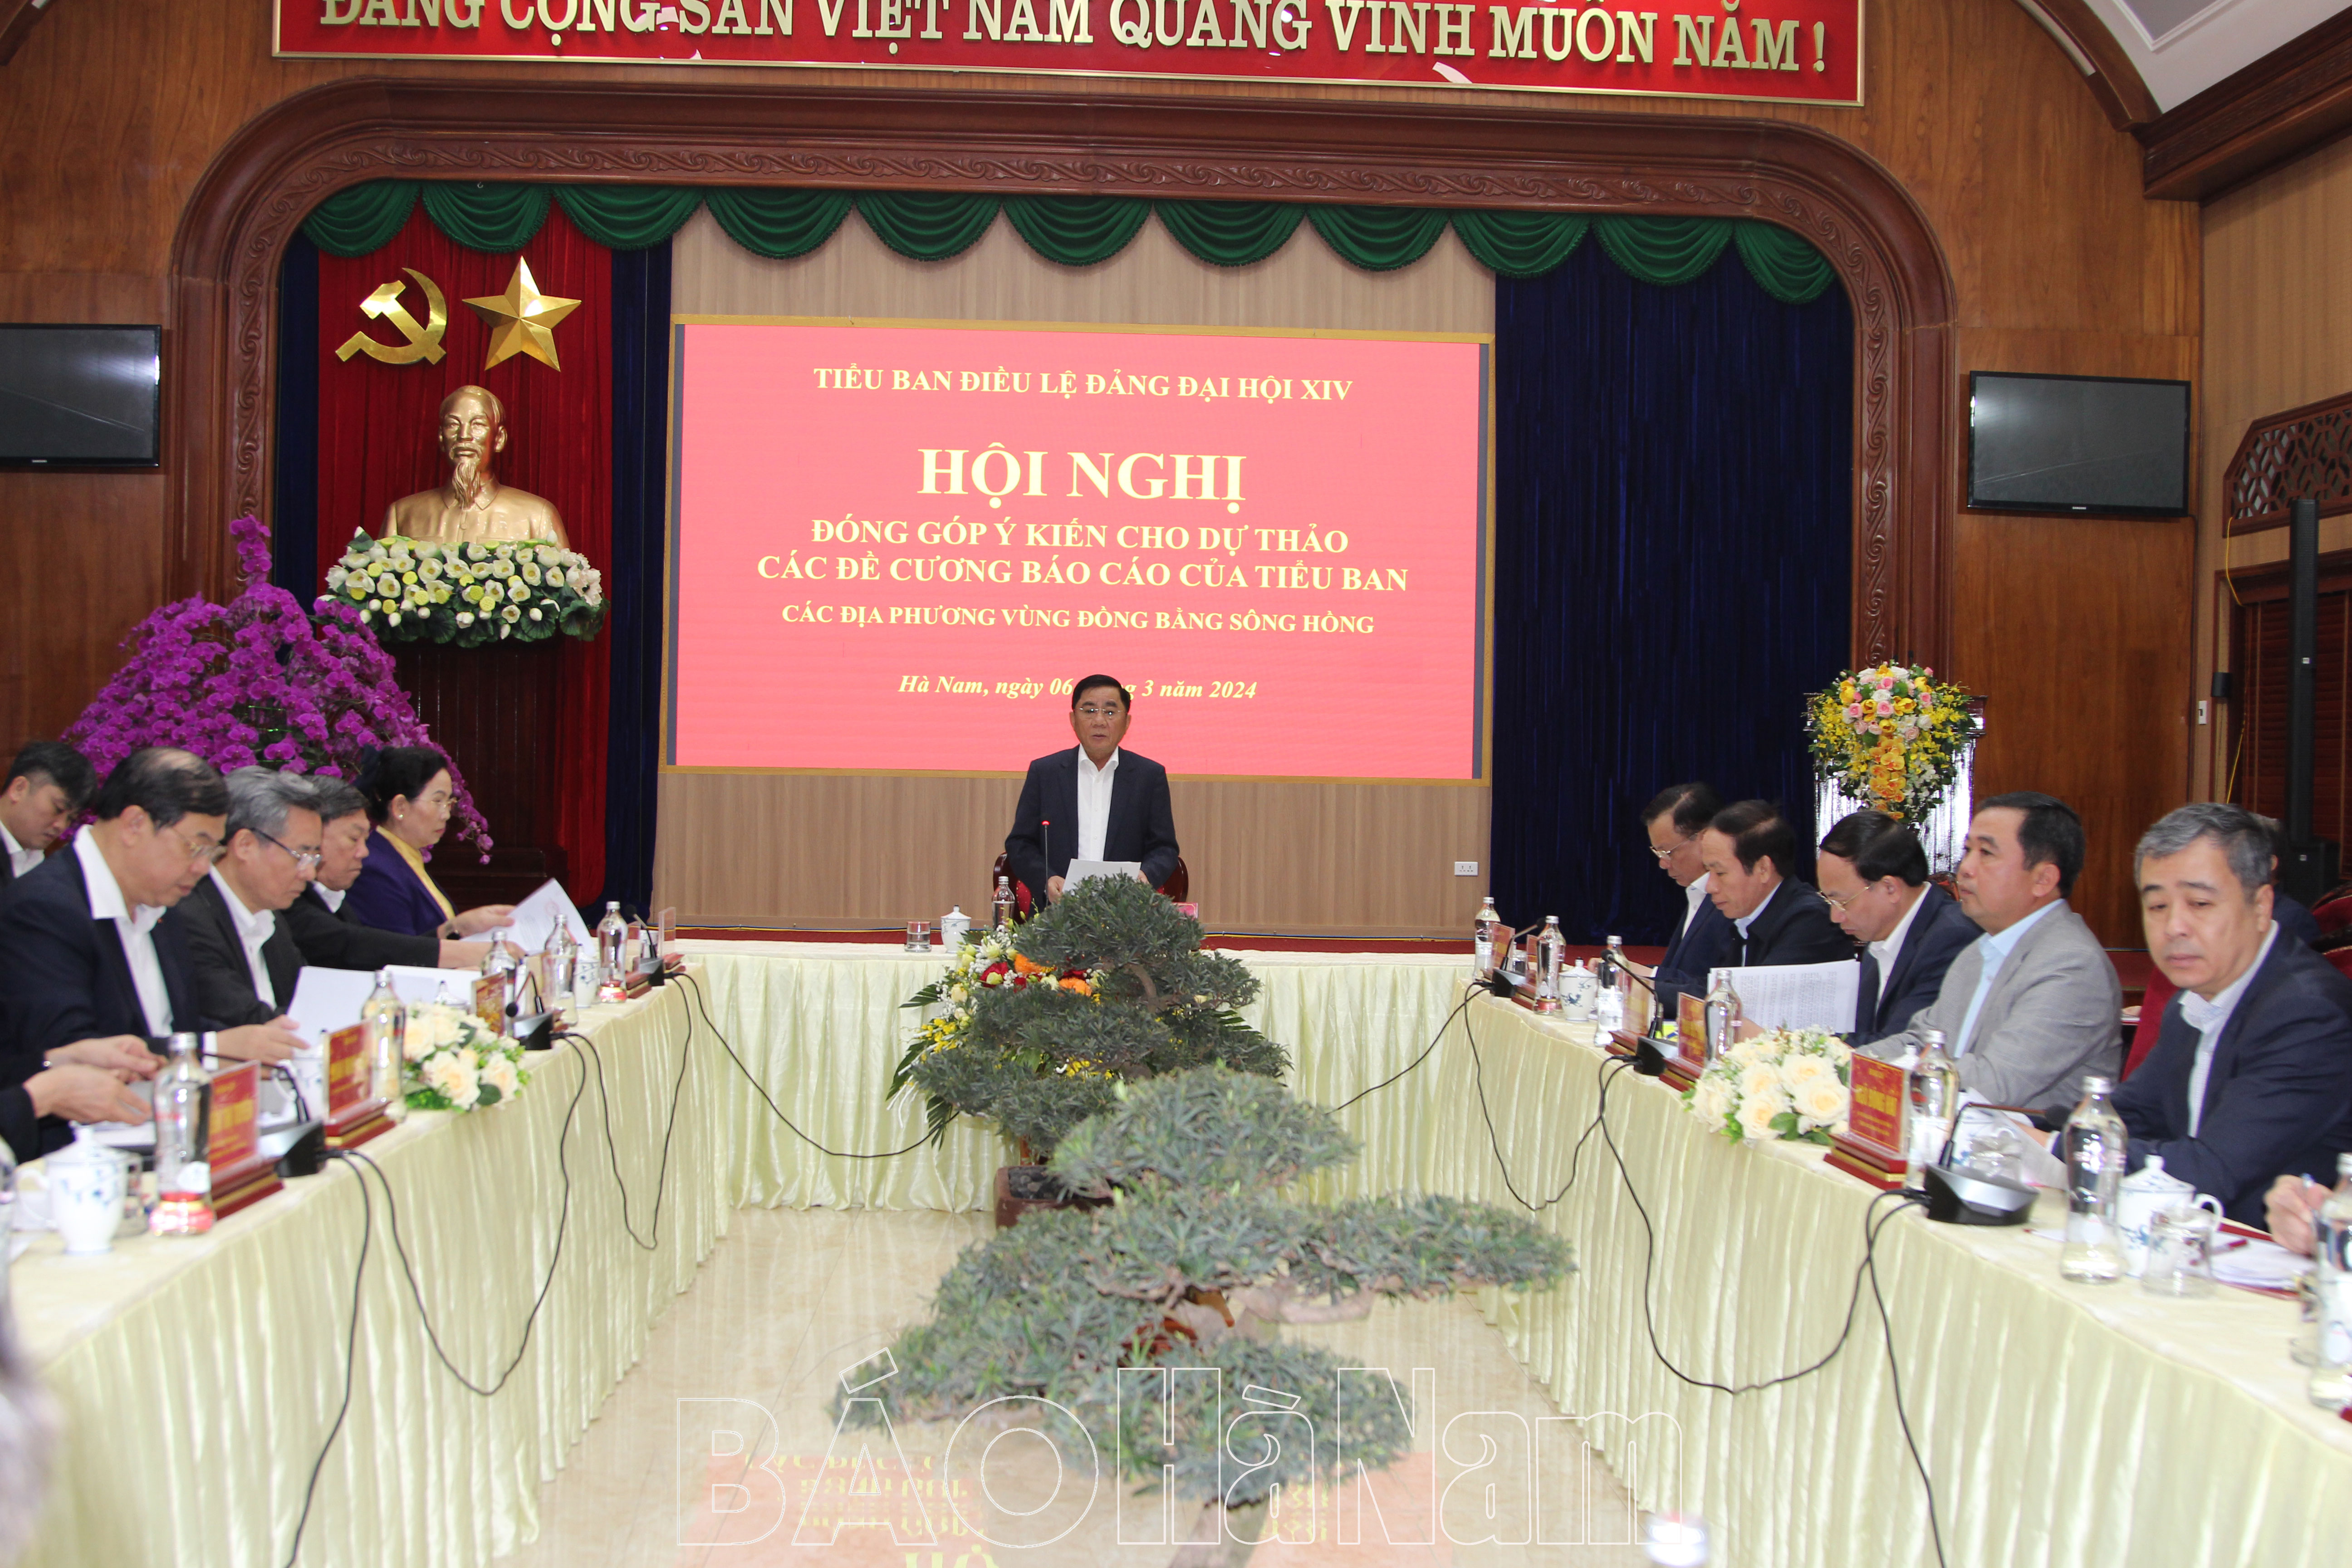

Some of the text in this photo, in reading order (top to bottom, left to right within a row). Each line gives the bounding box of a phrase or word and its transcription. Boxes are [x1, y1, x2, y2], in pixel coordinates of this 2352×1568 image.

[963, 0, 1094, 43] NAM
[1109, 0, 1313, 50] QUANG
[1325, 0, 1476, 56] VINH
[1489, 0, 1658, 63] MUÔN
[1673, 0, 1799, 71] NĂM
[813, 362, 1353, 405] TIỂU BAN ĐIỀU LỆ ĐẢNG ĐẠI HỘI XIV
[916, 441, 1247, 514] HỘI NGHỊ
[811, 513, 1349, 557] ĐÓNG GÓP Ý KIẾN CHO DỰ THẢO
[757, 549, 1409, 592] CÁC ĐỀ CƯƠNG BÁO CÁO CỦA TIỂU BAN
[782, 600, 1375, 634] CÁC ĐỊA PHƯƠNG VÙNG ĐỒNG BẰNG SÔNG HỒNG
[897, 675, 930, 693] Hà
[934, 676, 989, 697] Nam,
[995, 677, 1044, 700] ngày
[1049, 677, 1074, 696] 06
[1141, 679, 1154, 697] 3
[1159, 680, 1203, 698] năm
[1208, 681, 1258, 699] 2024
